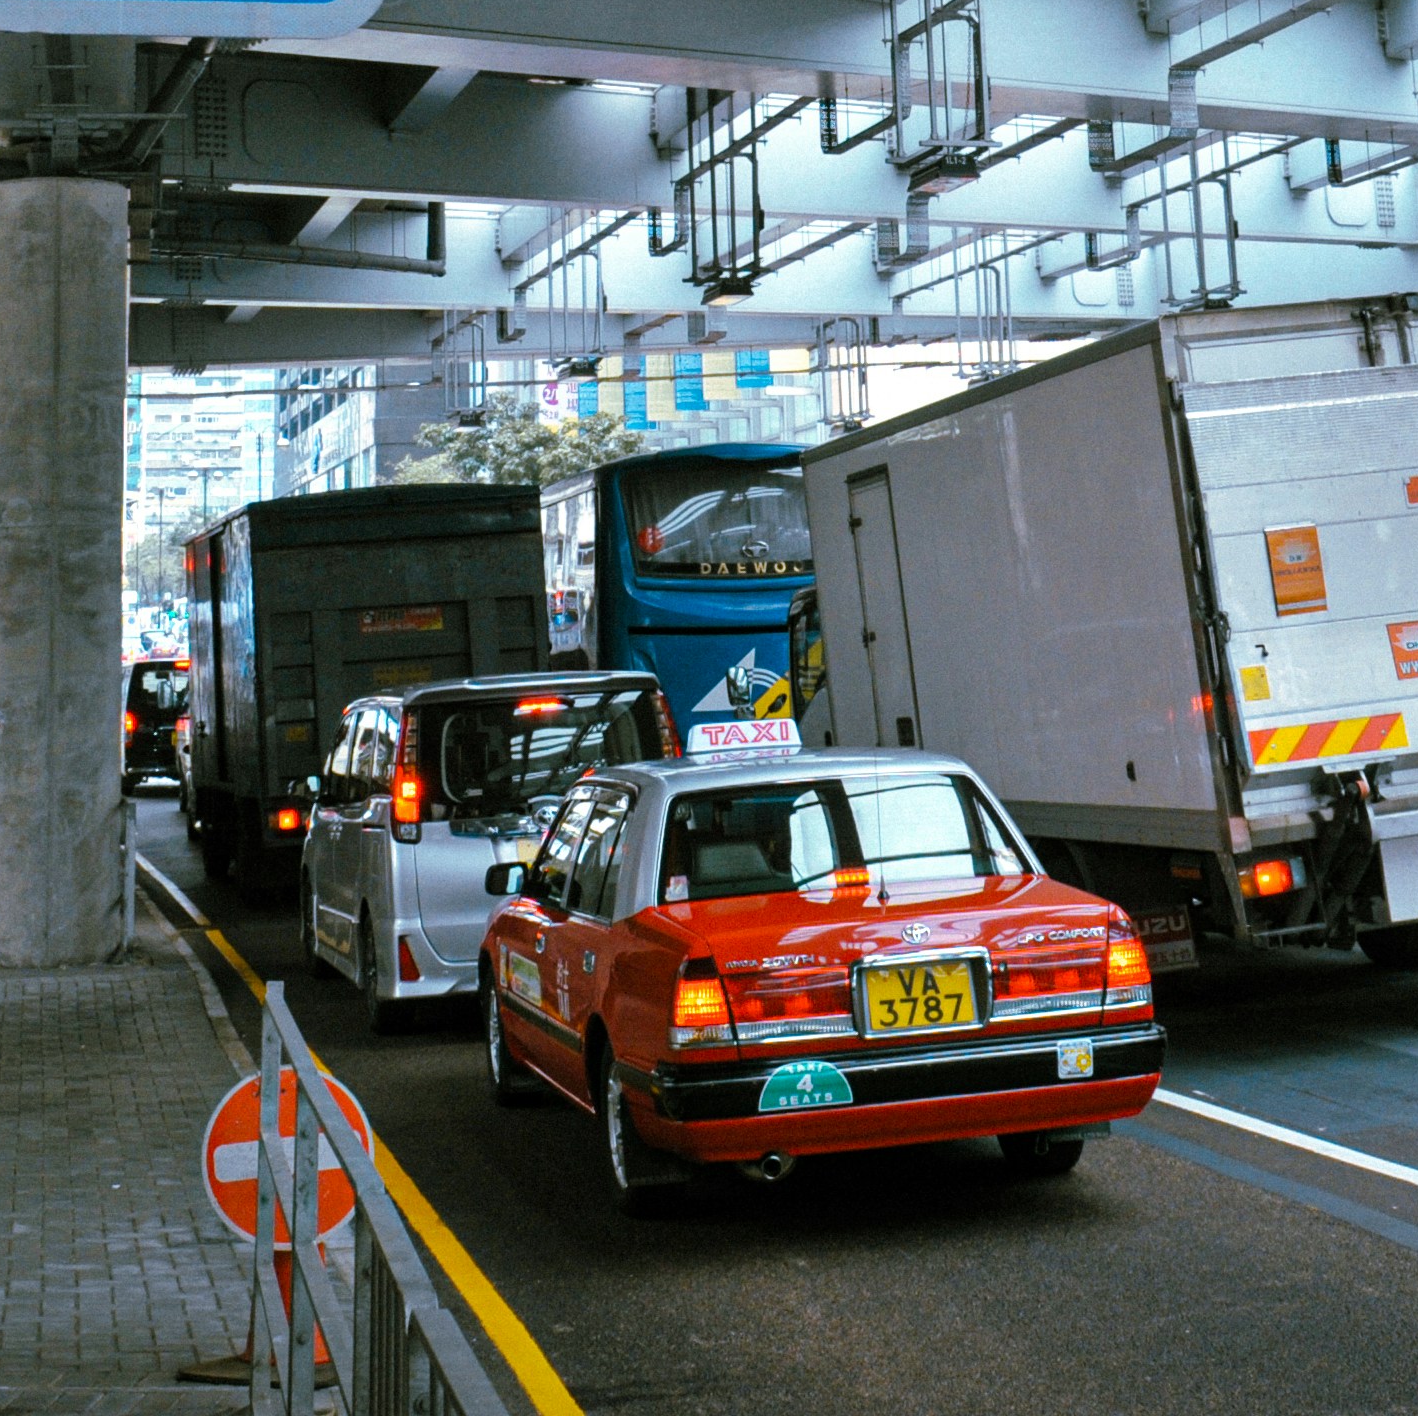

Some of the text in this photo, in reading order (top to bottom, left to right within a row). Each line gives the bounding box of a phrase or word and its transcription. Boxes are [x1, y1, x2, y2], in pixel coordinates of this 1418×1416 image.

[701, 721, 790, 746] TAXI
[1017, 925, 1106, 944] LPG COMFORT
[896, 967, 941, 996] VA
[879, 992, 964, 1028] 3787
[796, 1073, 814, 1093] 4
[779, 1092, 833, 1106] SEATS
